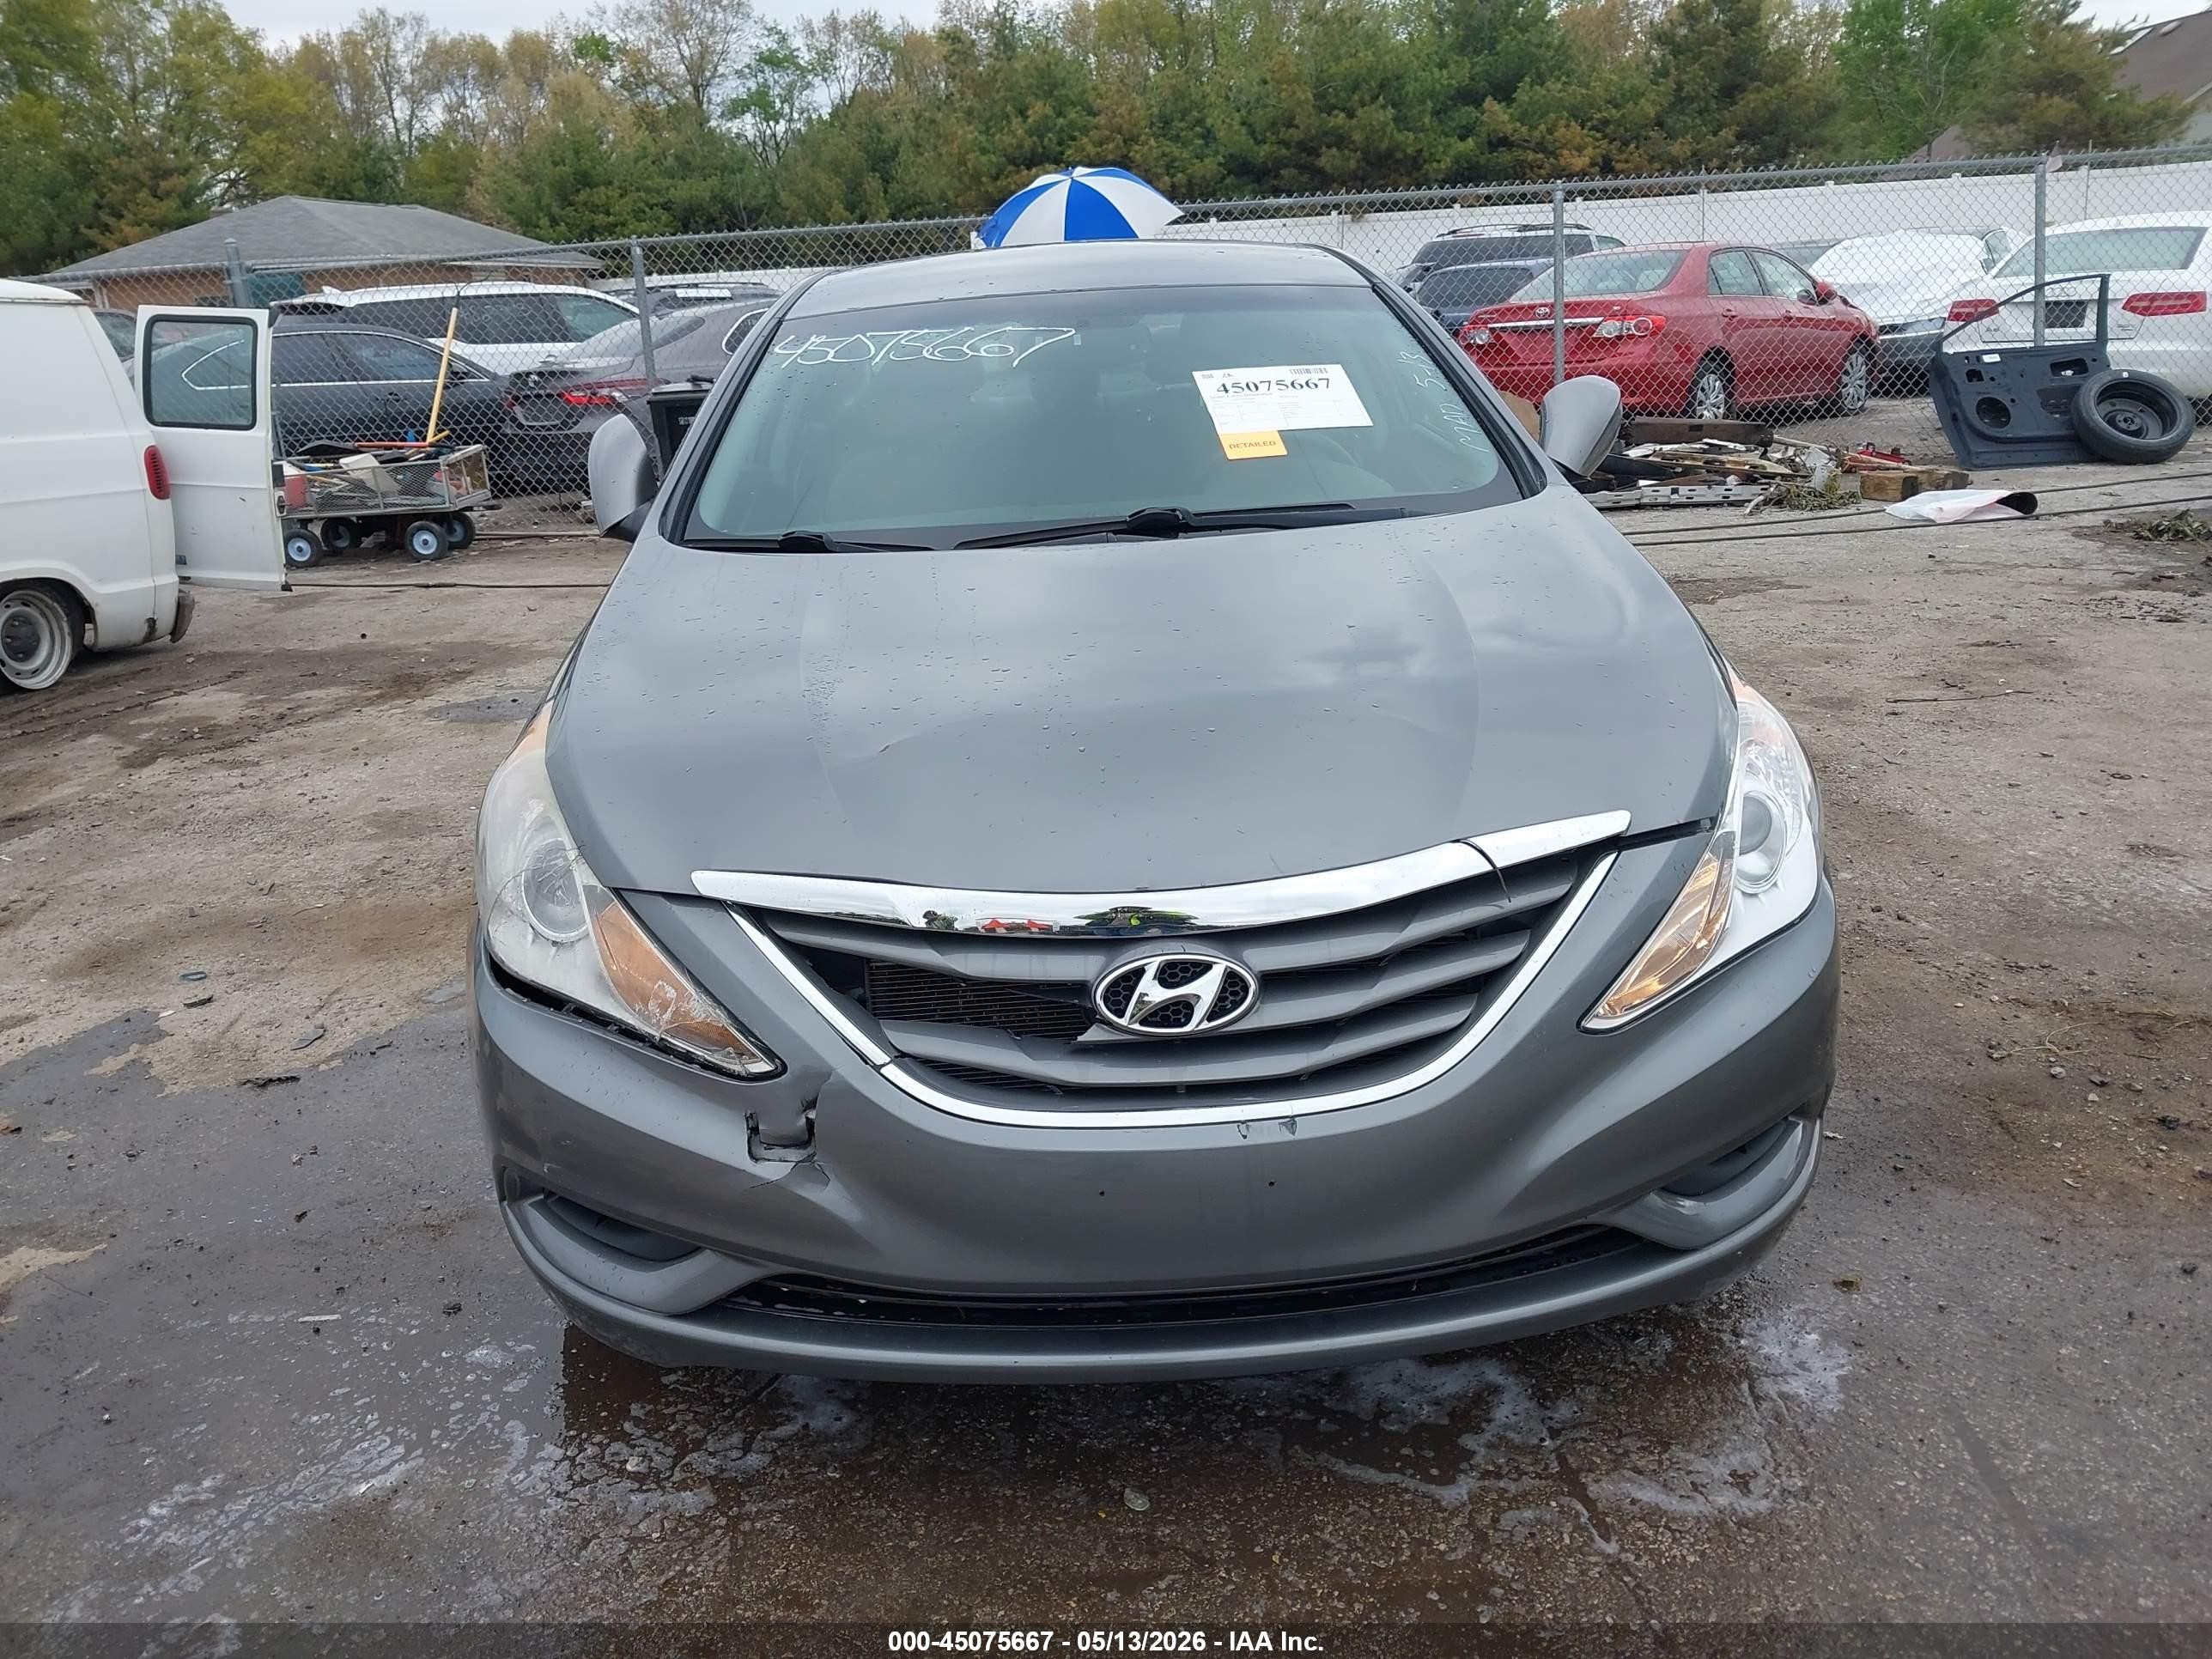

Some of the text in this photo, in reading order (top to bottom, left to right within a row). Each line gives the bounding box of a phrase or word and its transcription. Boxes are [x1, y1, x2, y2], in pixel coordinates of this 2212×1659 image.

[774, 326, 1076, 368] 45075667
[1216, 378, 1331, 394] 45075667
[1229, 441, 1277, 450] DETAILED
